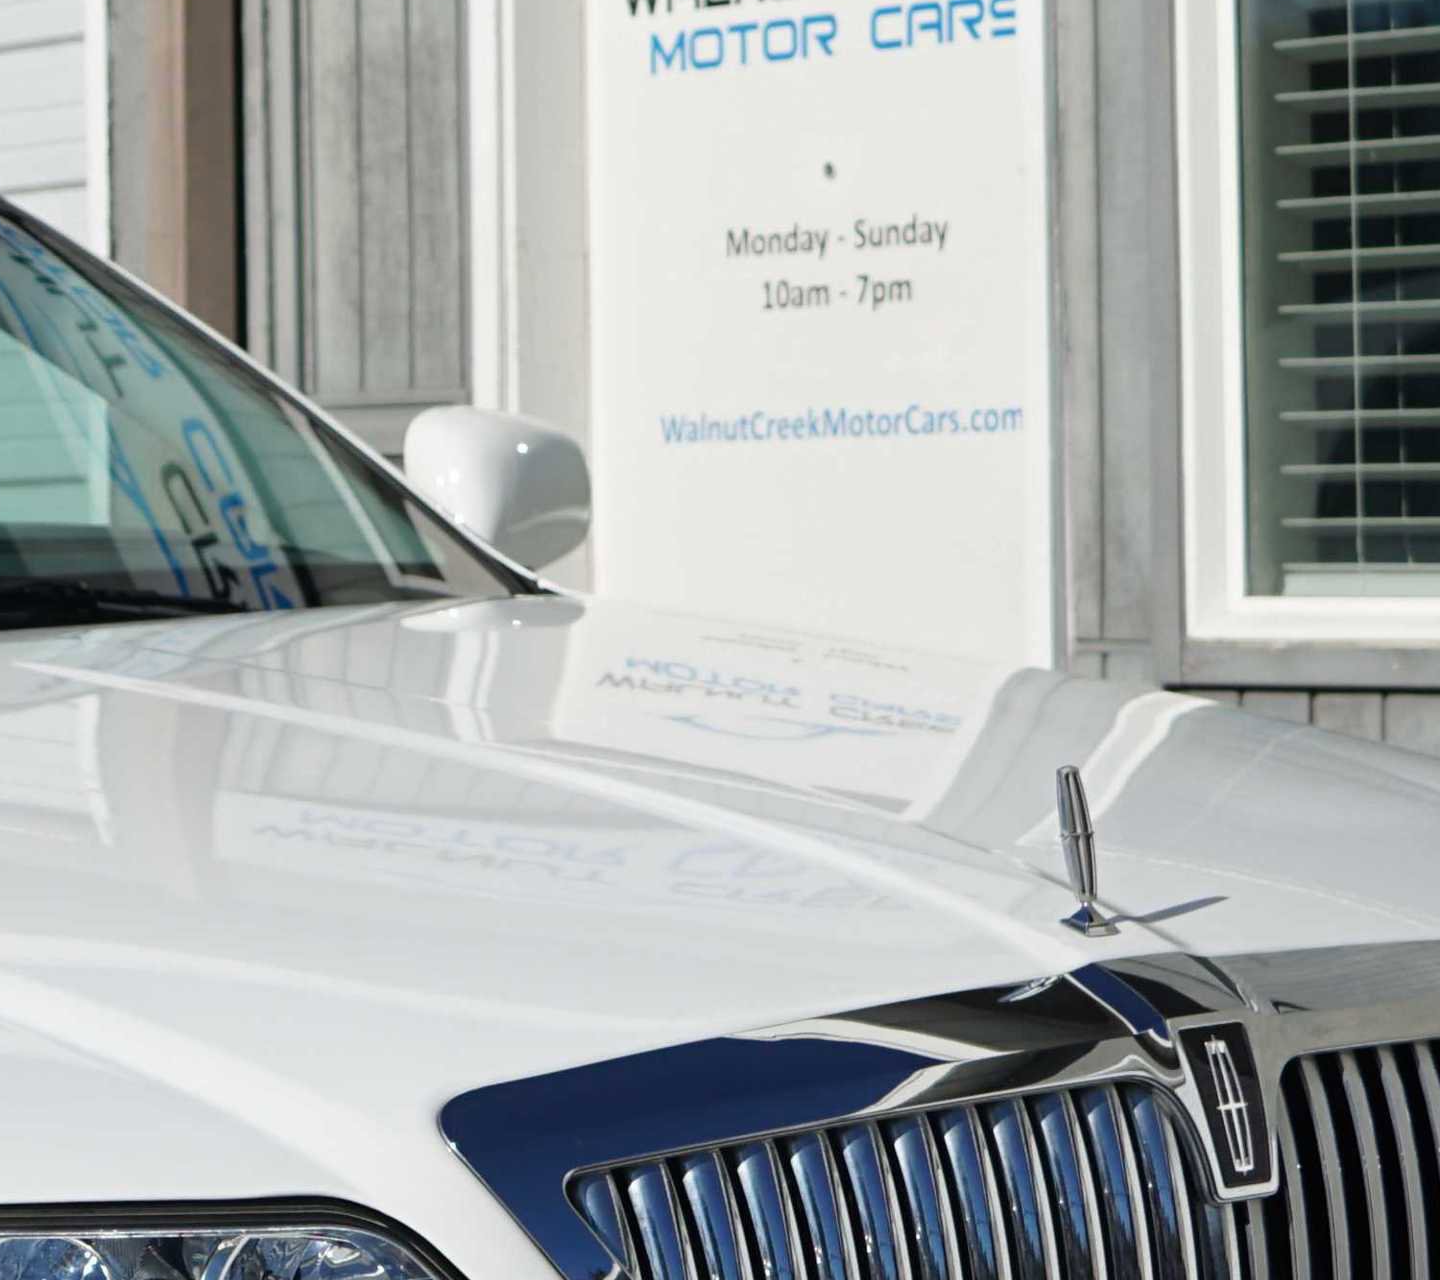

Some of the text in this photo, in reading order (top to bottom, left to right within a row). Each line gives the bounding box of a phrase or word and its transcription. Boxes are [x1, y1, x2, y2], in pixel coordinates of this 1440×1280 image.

[649, 13, 839, 74] MOTOR
[726, 224, 829, 258] Monday
[853, 215, 949, 251] Sunday
[762, 279, 830, 310] 10am
[856, 274, 913, 311] 7pm
[659, 402, 1023, 443] WalnutCreekMotorCars.com
